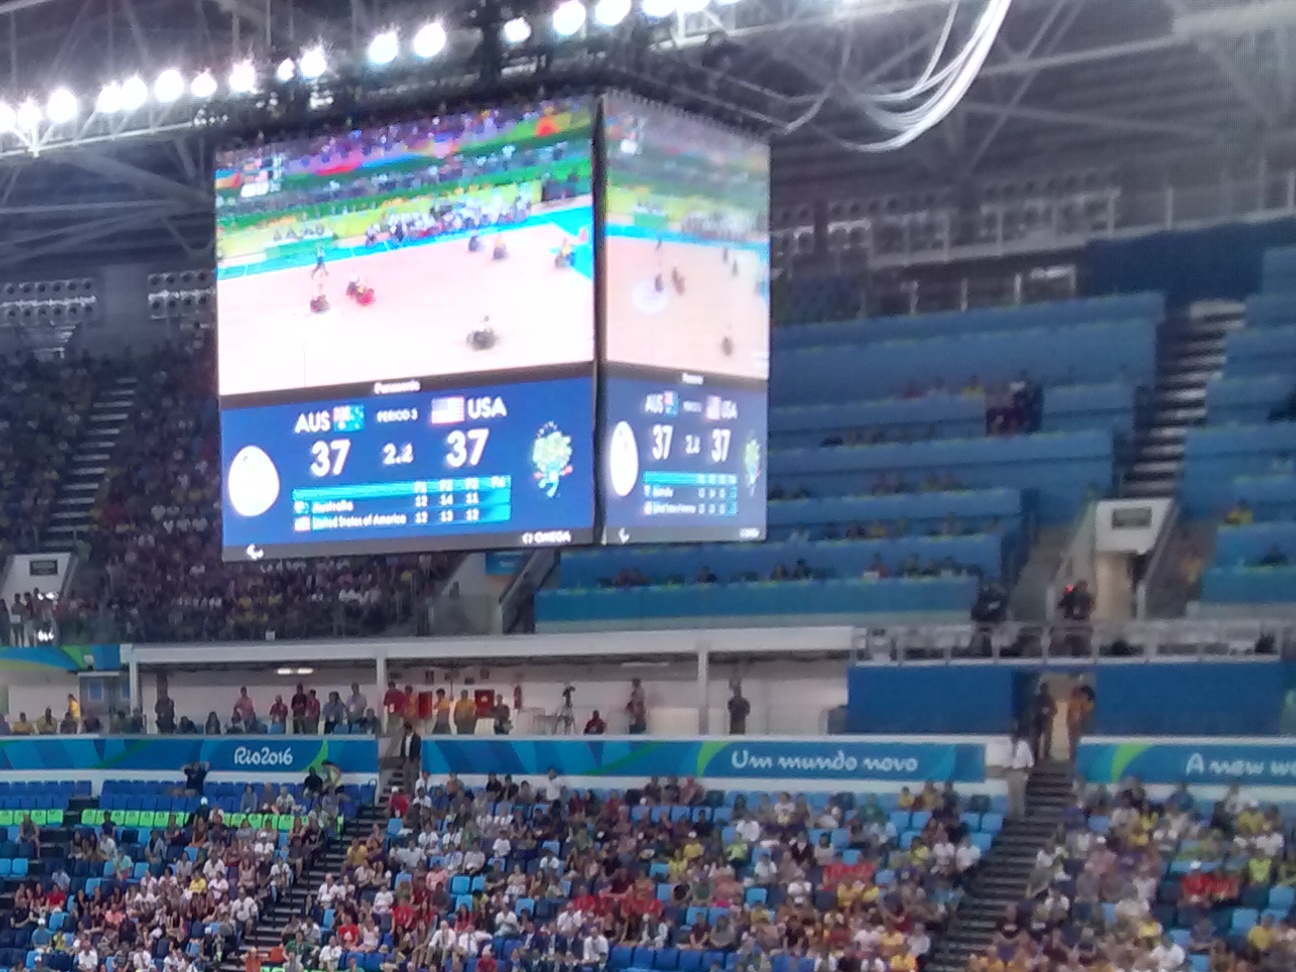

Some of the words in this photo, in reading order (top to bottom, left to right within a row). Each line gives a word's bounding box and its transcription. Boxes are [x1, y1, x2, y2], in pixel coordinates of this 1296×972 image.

[377, 411, 411, 423] PERIOD
[467, 397, 507, 419] USA
[294, 411, 331, 434] AUS
[446, 428, 490, 468] 37
[652, 424, 673, 460] 37
[711, 428, 731, 465] 37
[310, 439, 351, 477] 37
[234, 746, 294, 766] Rio2016
[731, 749, 772, 769] Um
[777, 749, 858, 772] mundo
[863, 756, 919, 772] novo
[1185, 753, 1204, 776] A
[1208, 760, 1264, 776] new
